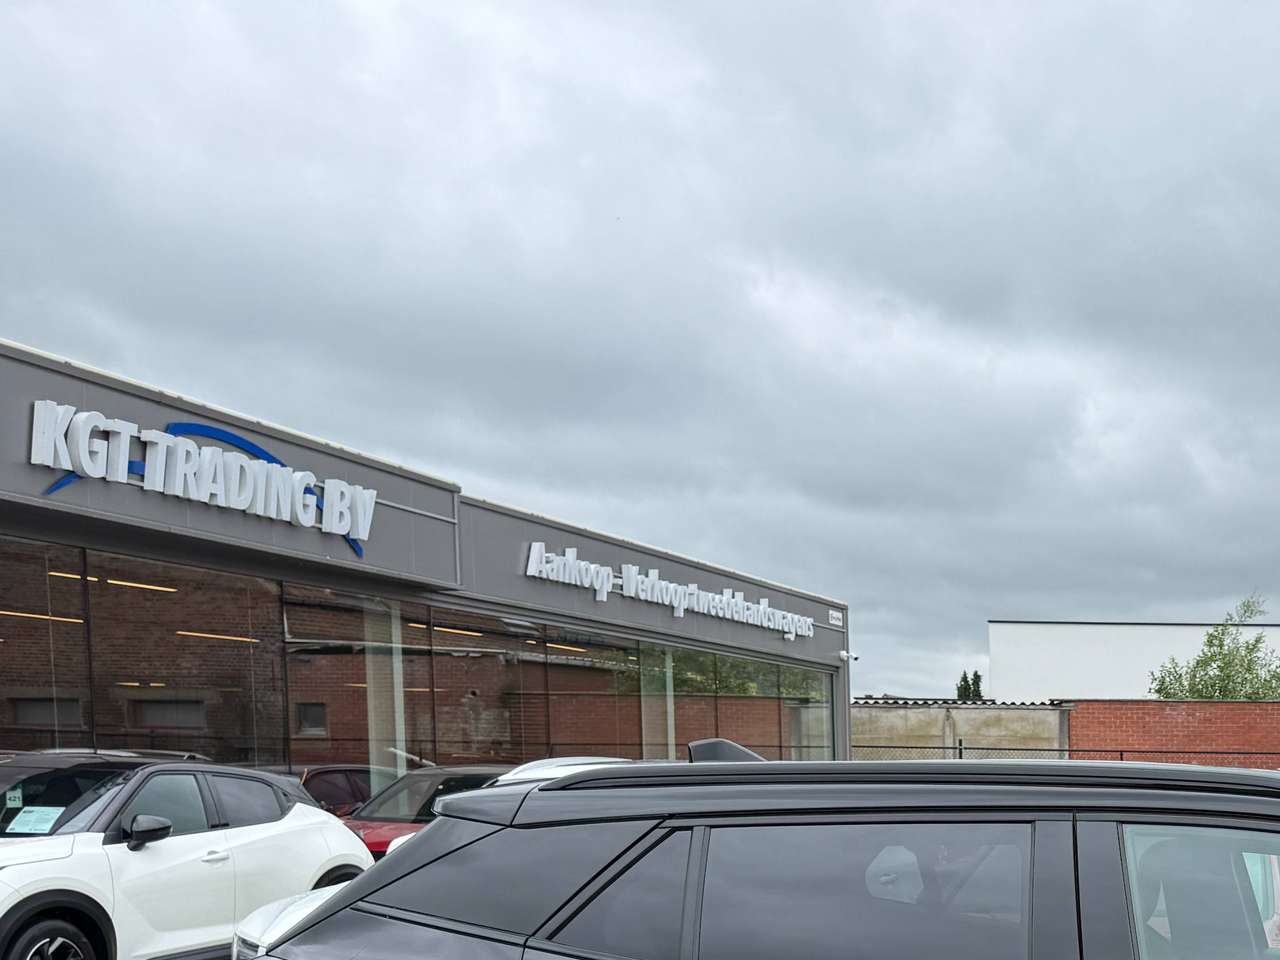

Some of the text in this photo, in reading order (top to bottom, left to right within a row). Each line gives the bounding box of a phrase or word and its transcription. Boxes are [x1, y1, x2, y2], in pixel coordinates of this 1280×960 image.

[31, 400, 377, 541] KGT TRADING BV
[527, 542, 613, 602] Aankoop
